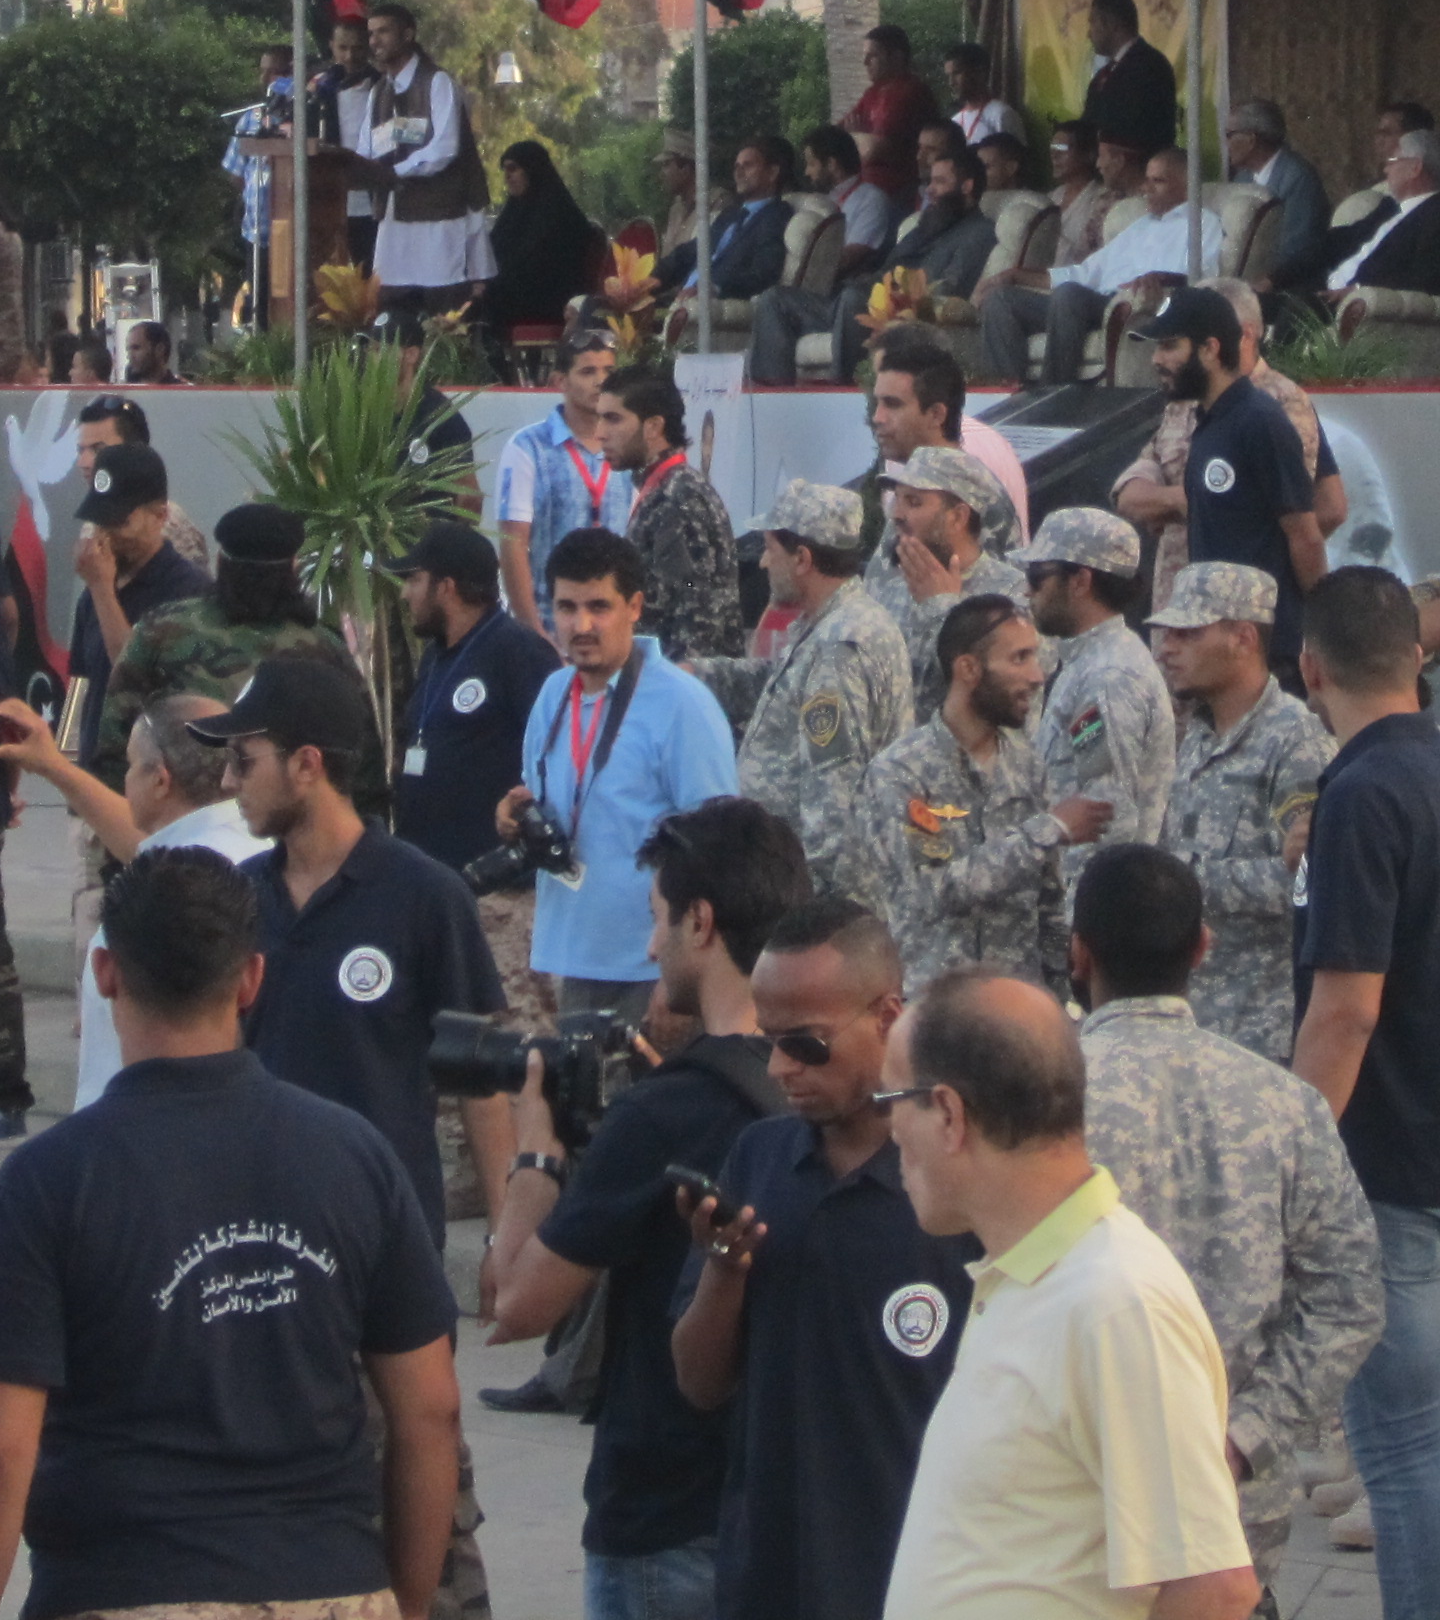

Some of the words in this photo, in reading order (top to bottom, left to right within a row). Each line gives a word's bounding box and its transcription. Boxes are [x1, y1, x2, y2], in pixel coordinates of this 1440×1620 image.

[198, 1219, 274, 1253] المشتركة
[276, 1222, 338, 1278] الغرفة
[200, 1274, 234, 1298] المركز
[235, 1265, 295, 1290] طرابلس
